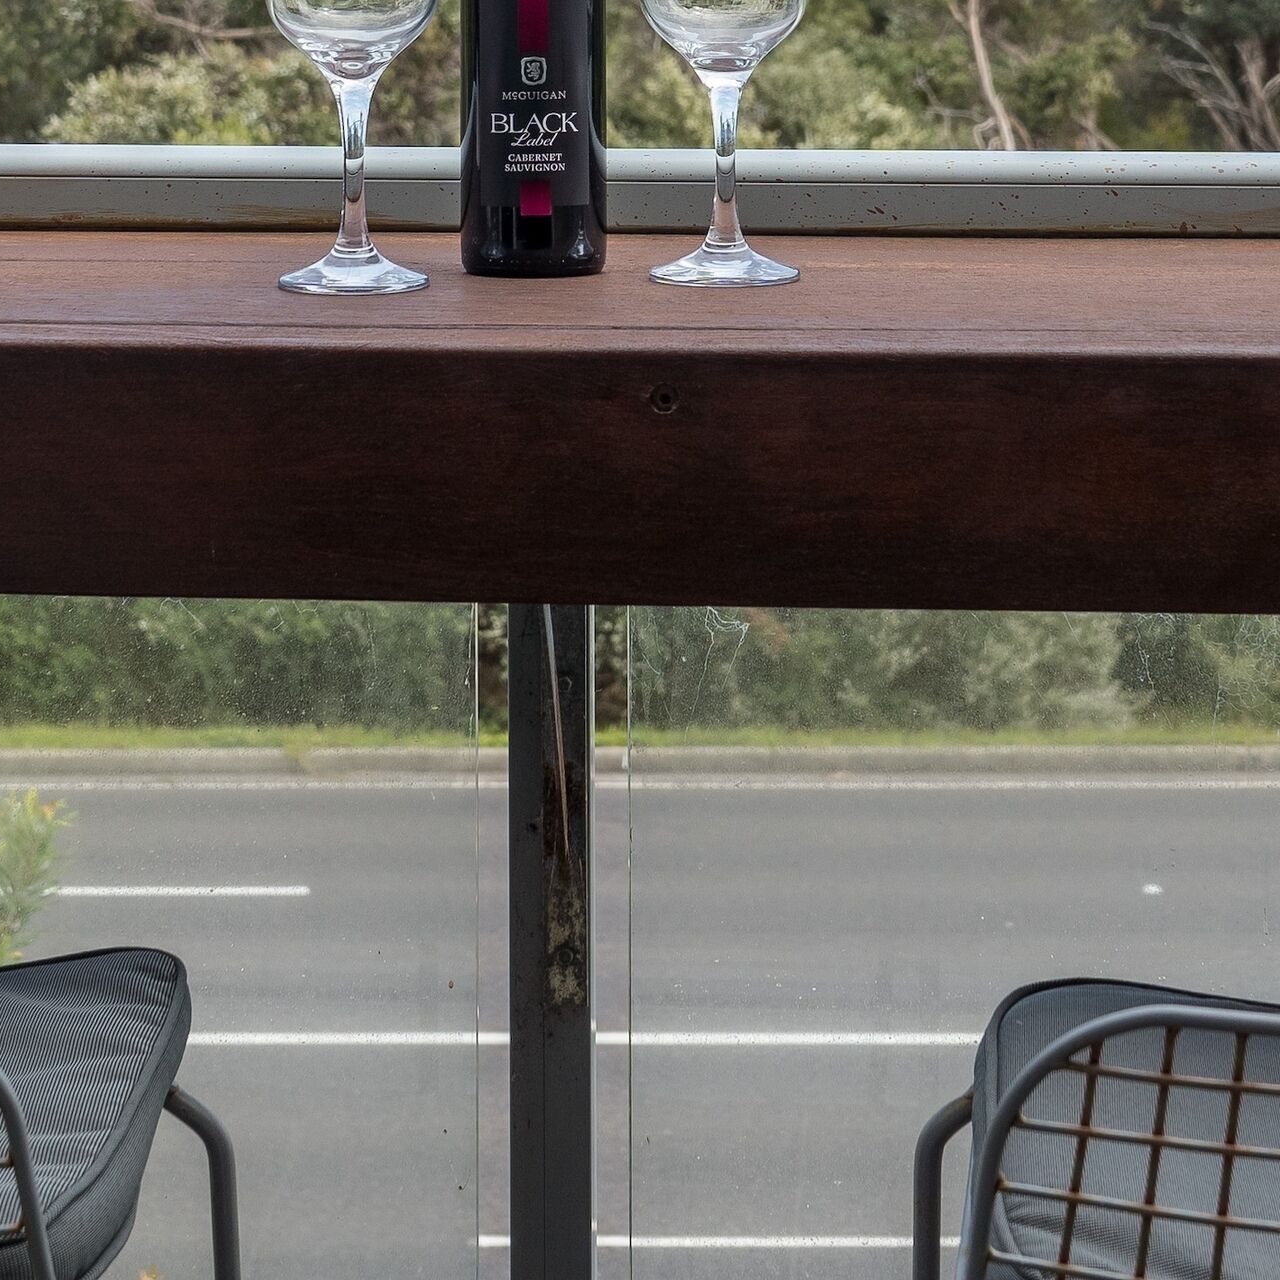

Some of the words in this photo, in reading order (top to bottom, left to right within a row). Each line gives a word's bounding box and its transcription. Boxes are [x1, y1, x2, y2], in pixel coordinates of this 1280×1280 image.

[502, 90, 567, 100] McGUIGAN
[490, 112, 579, 133] BLACK
[510, 132, 558, 147] Label
[508, 153, 563, 162] CABERNET
[504, 163, 566, 172] SAUVIGNON
